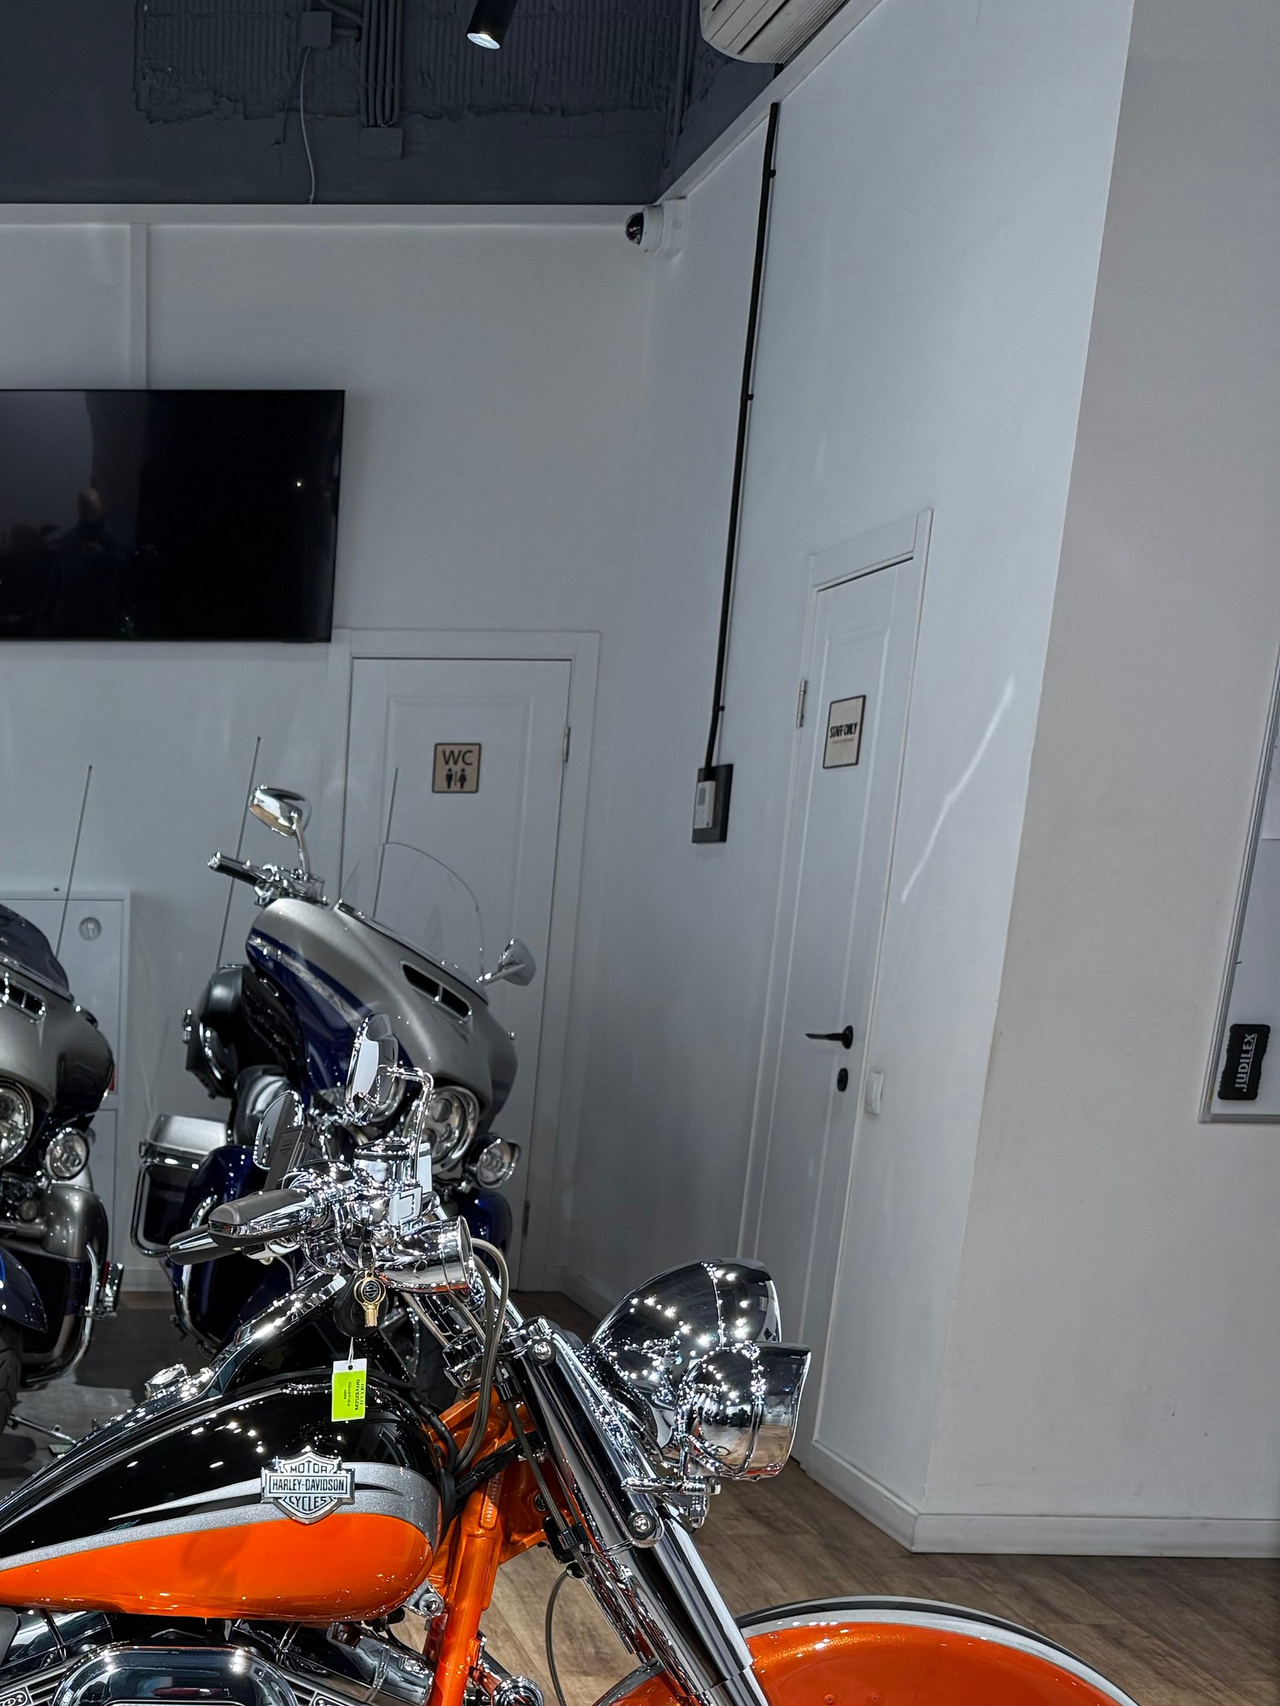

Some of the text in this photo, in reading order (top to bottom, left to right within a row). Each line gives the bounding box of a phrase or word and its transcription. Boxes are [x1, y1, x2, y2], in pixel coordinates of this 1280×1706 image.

[442, 750, 473, 766] WC
[1235, 1033, 1256, 1092] JUDILEX
[290, 1461, 327, 1473] MOTOR
[272, 1478, 345, 1491] HARLEY-DAVIDSON
[289, 1496, 327, 1511] CYCLES
